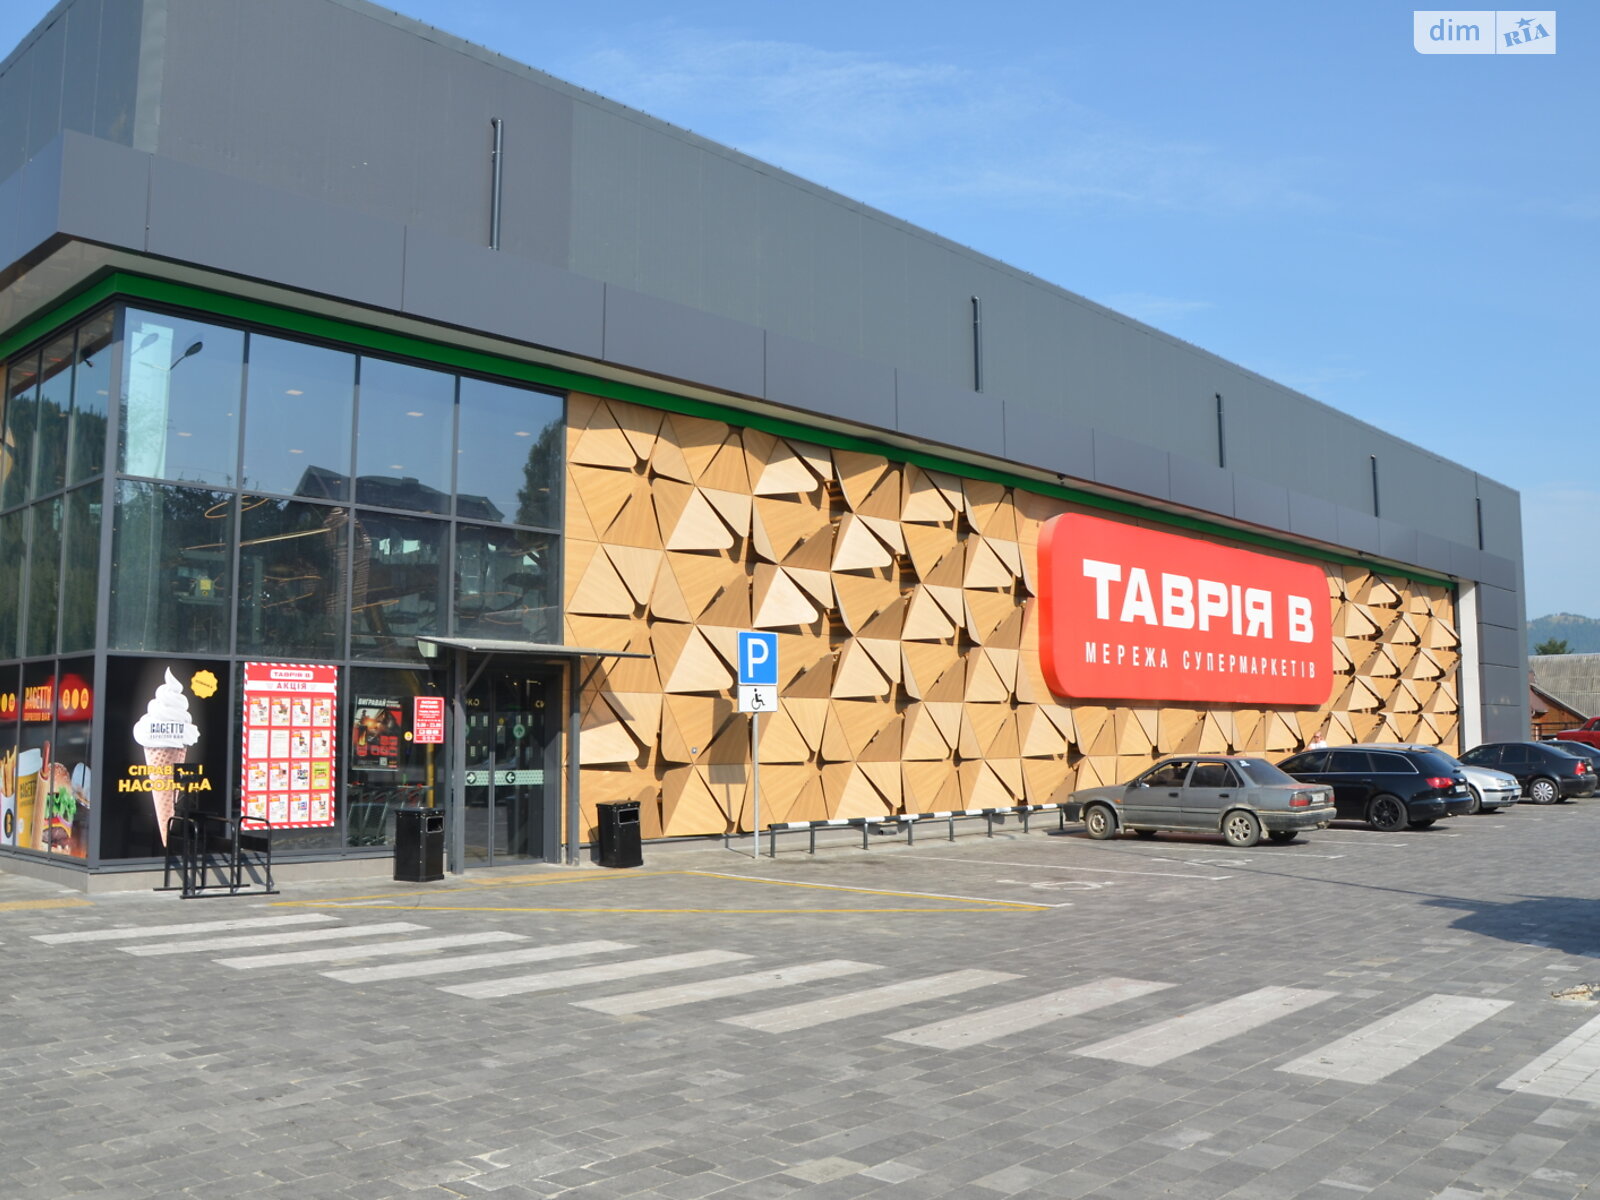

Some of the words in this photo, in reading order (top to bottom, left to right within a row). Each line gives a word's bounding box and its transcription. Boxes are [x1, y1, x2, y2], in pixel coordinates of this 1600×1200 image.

[1083, 558, 1274, 640] ТАВРІЯ
[1288, 594, 1315, 644] В
[747, 638, 769, 678] P
[1085, 641, 1168, 669] МЕРЕЖА
[1182, 650, 1316, 679] СУПЕРМАРКЕТІВ
[276, 682, 307, 691] АКЦІЯ
